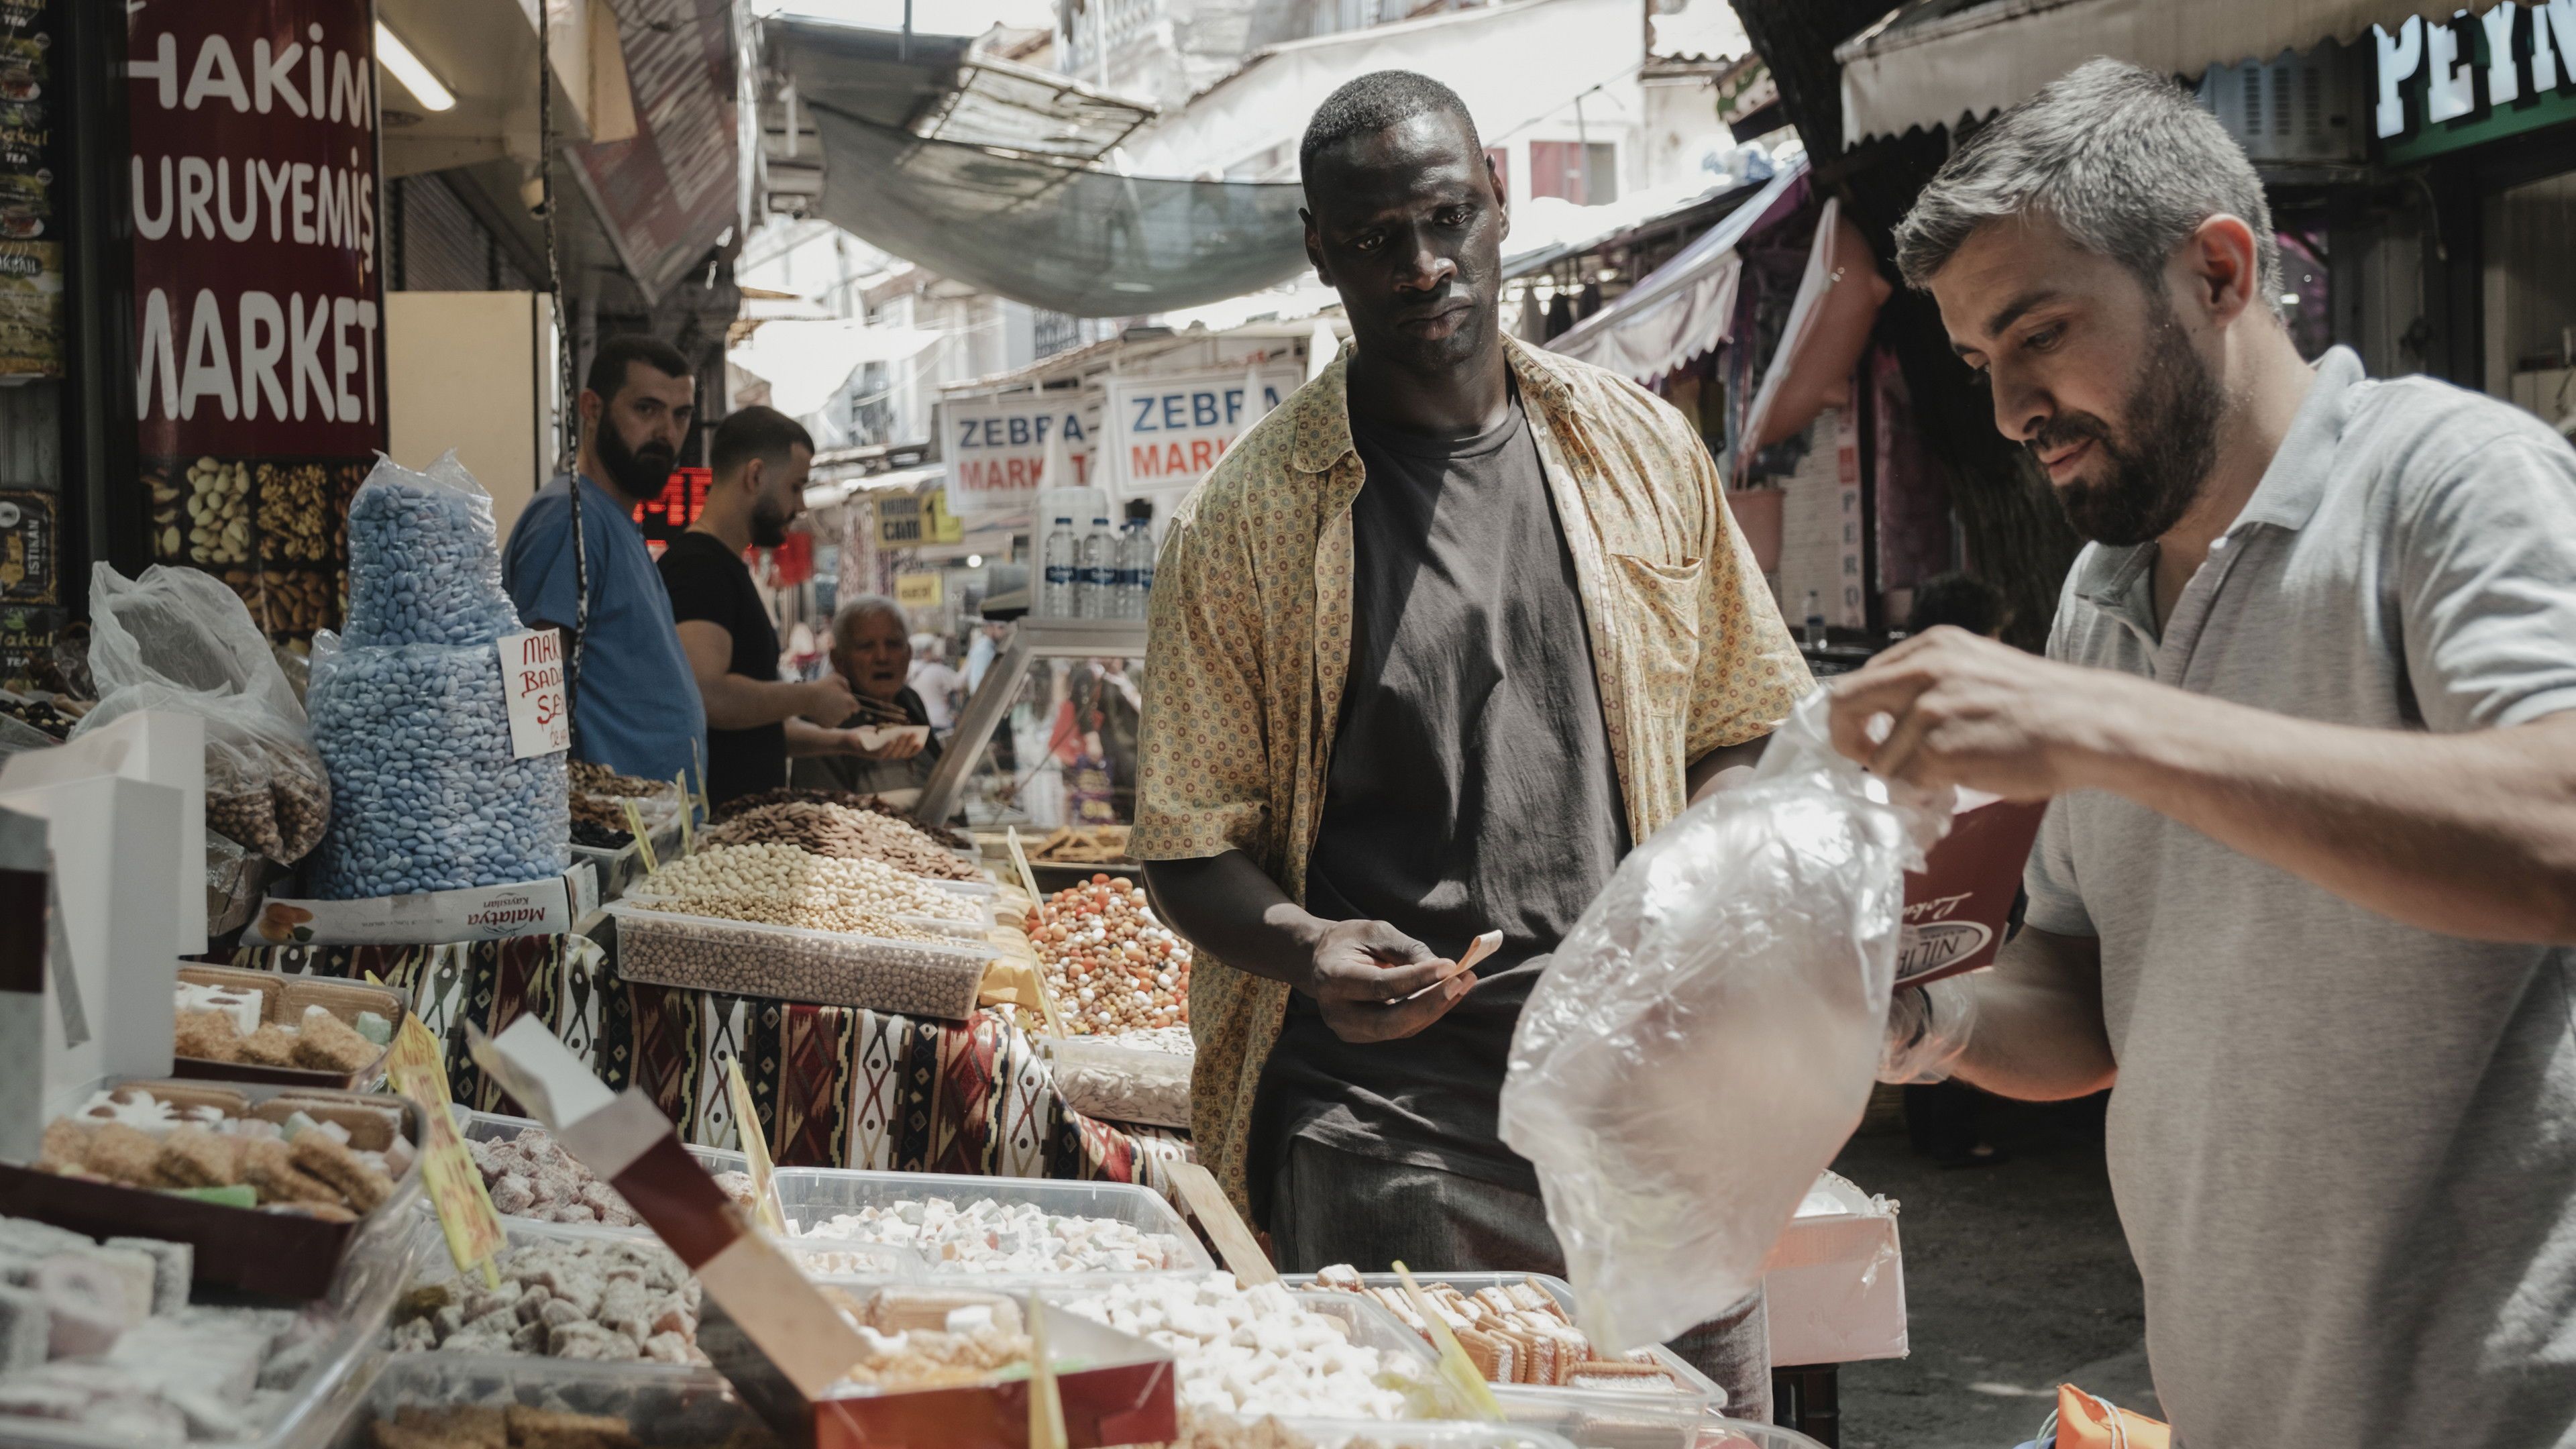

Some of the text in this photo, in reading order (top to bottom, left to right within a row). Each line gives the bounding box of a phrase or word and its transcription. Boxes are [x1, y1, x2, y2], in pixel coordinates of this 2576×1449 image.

[136, 288, 378, 426] MARKET
[959, 453, 1087, 492] MARKT
[468, 906, 545, 926] Malatya
